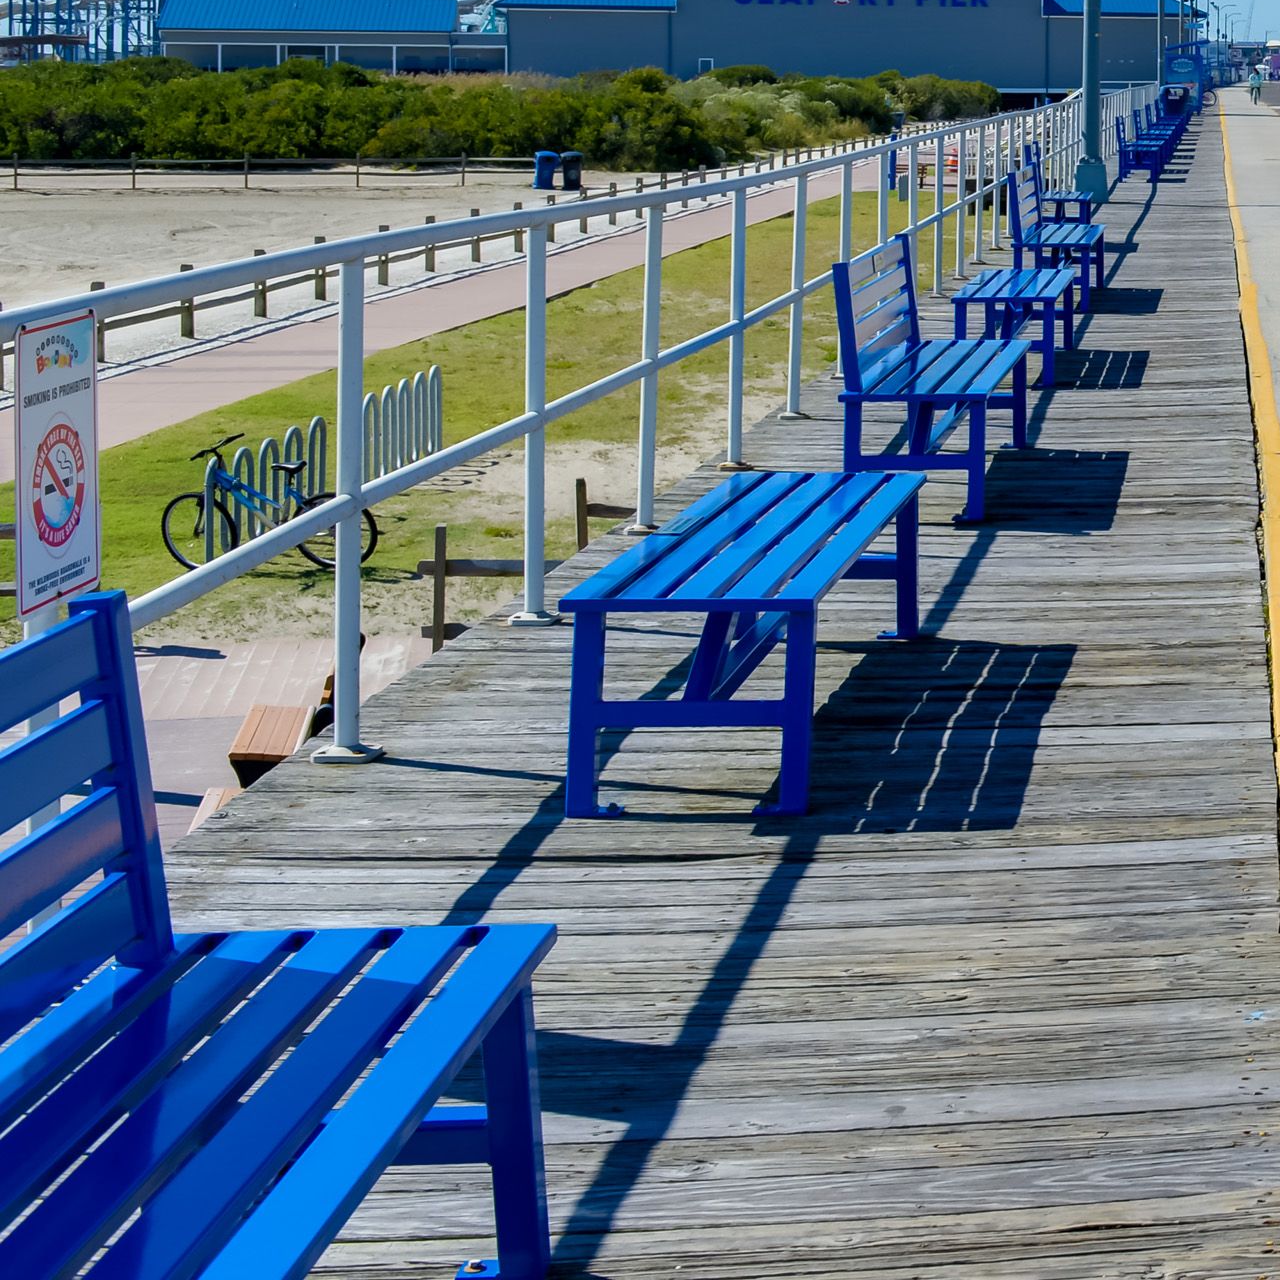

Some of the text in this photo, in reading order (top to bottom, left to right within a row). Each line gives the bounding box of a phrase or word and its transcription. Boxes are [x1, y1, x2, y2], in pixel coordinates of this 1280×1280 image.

[23, 377, 91, 409] SMOKING IS PROHIBITED
[35, 444, 48, 483] SMOKE
[46, 429, 60, 448] FREE
